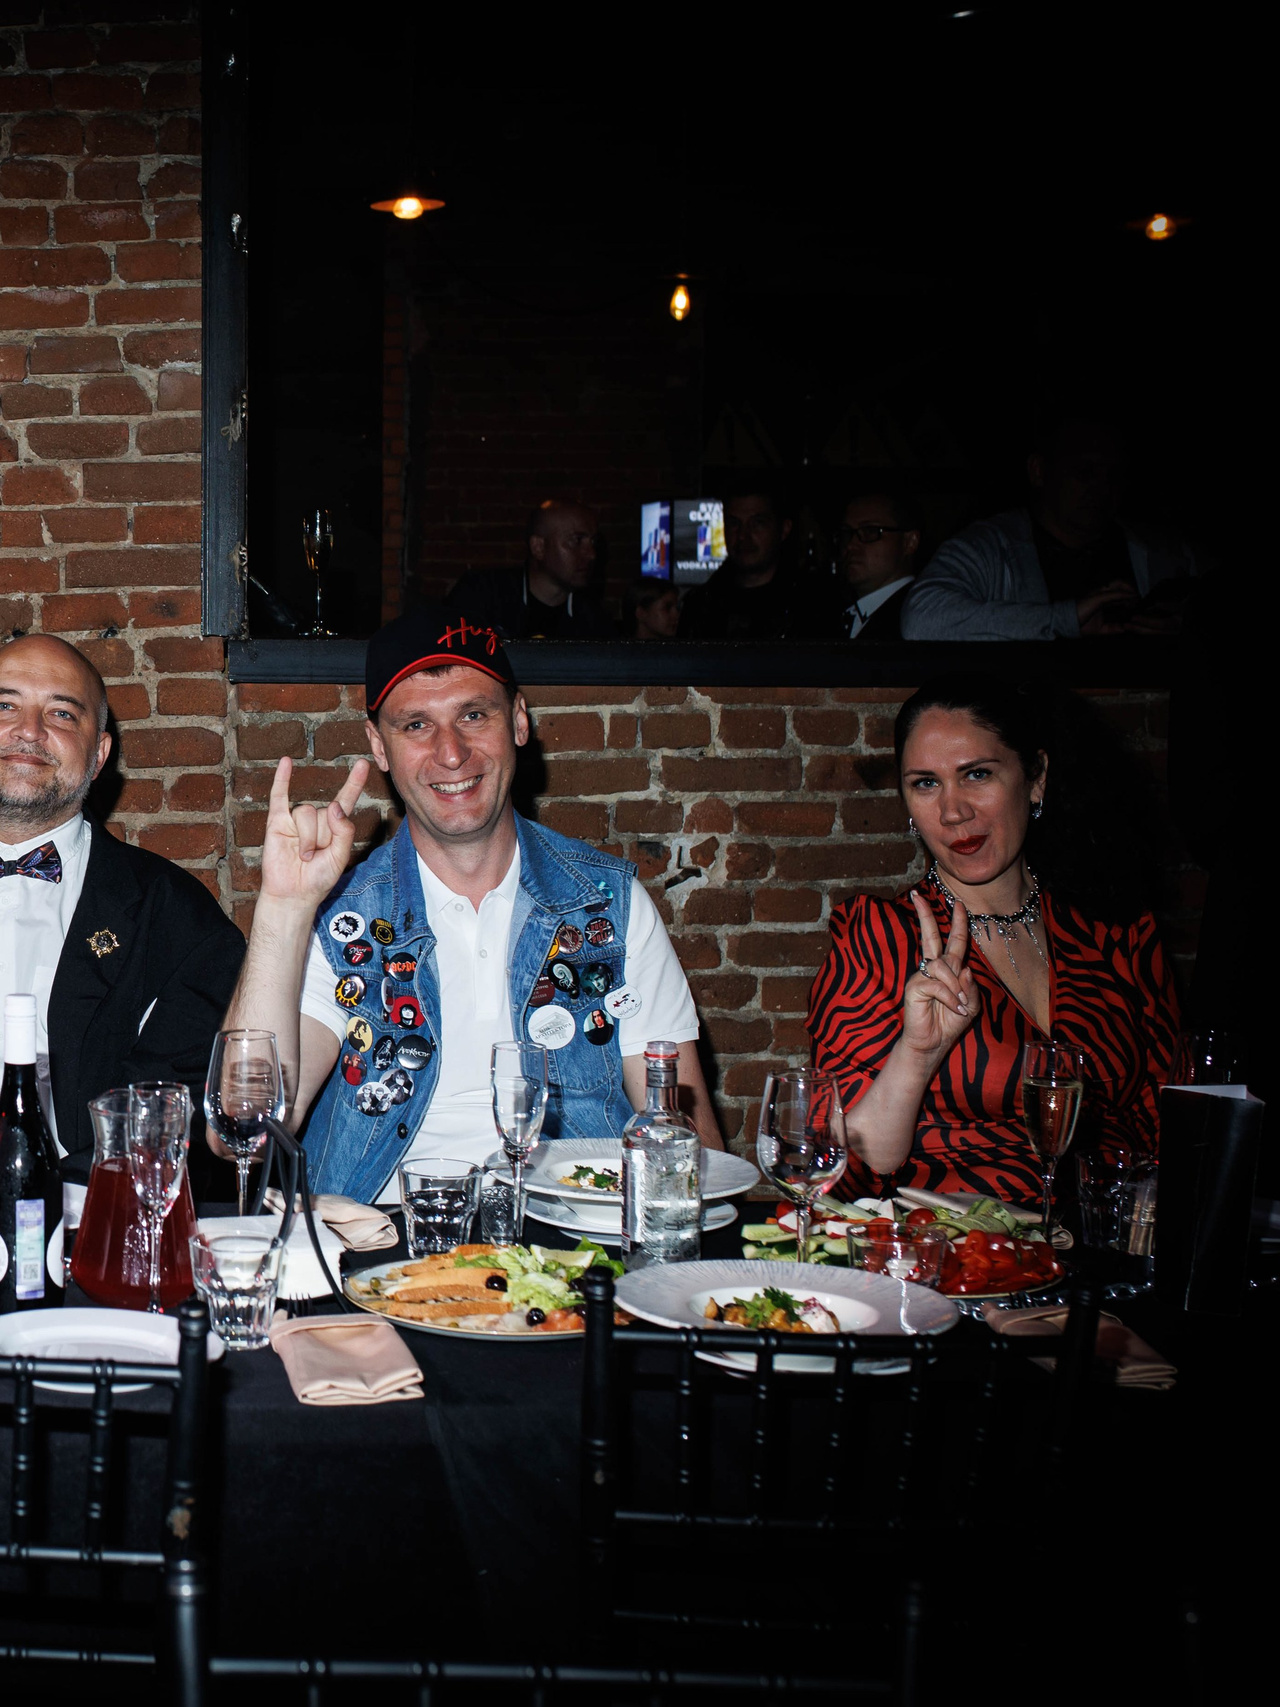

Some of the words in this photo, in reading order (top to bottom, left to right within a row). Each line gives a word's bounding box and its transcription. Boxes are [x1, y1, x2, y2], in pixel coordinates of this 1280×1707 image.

[676, 560, 706, 571] VODKA
[708, 560, 723, 570] RE
[437, 617, 503, 656] Hug
